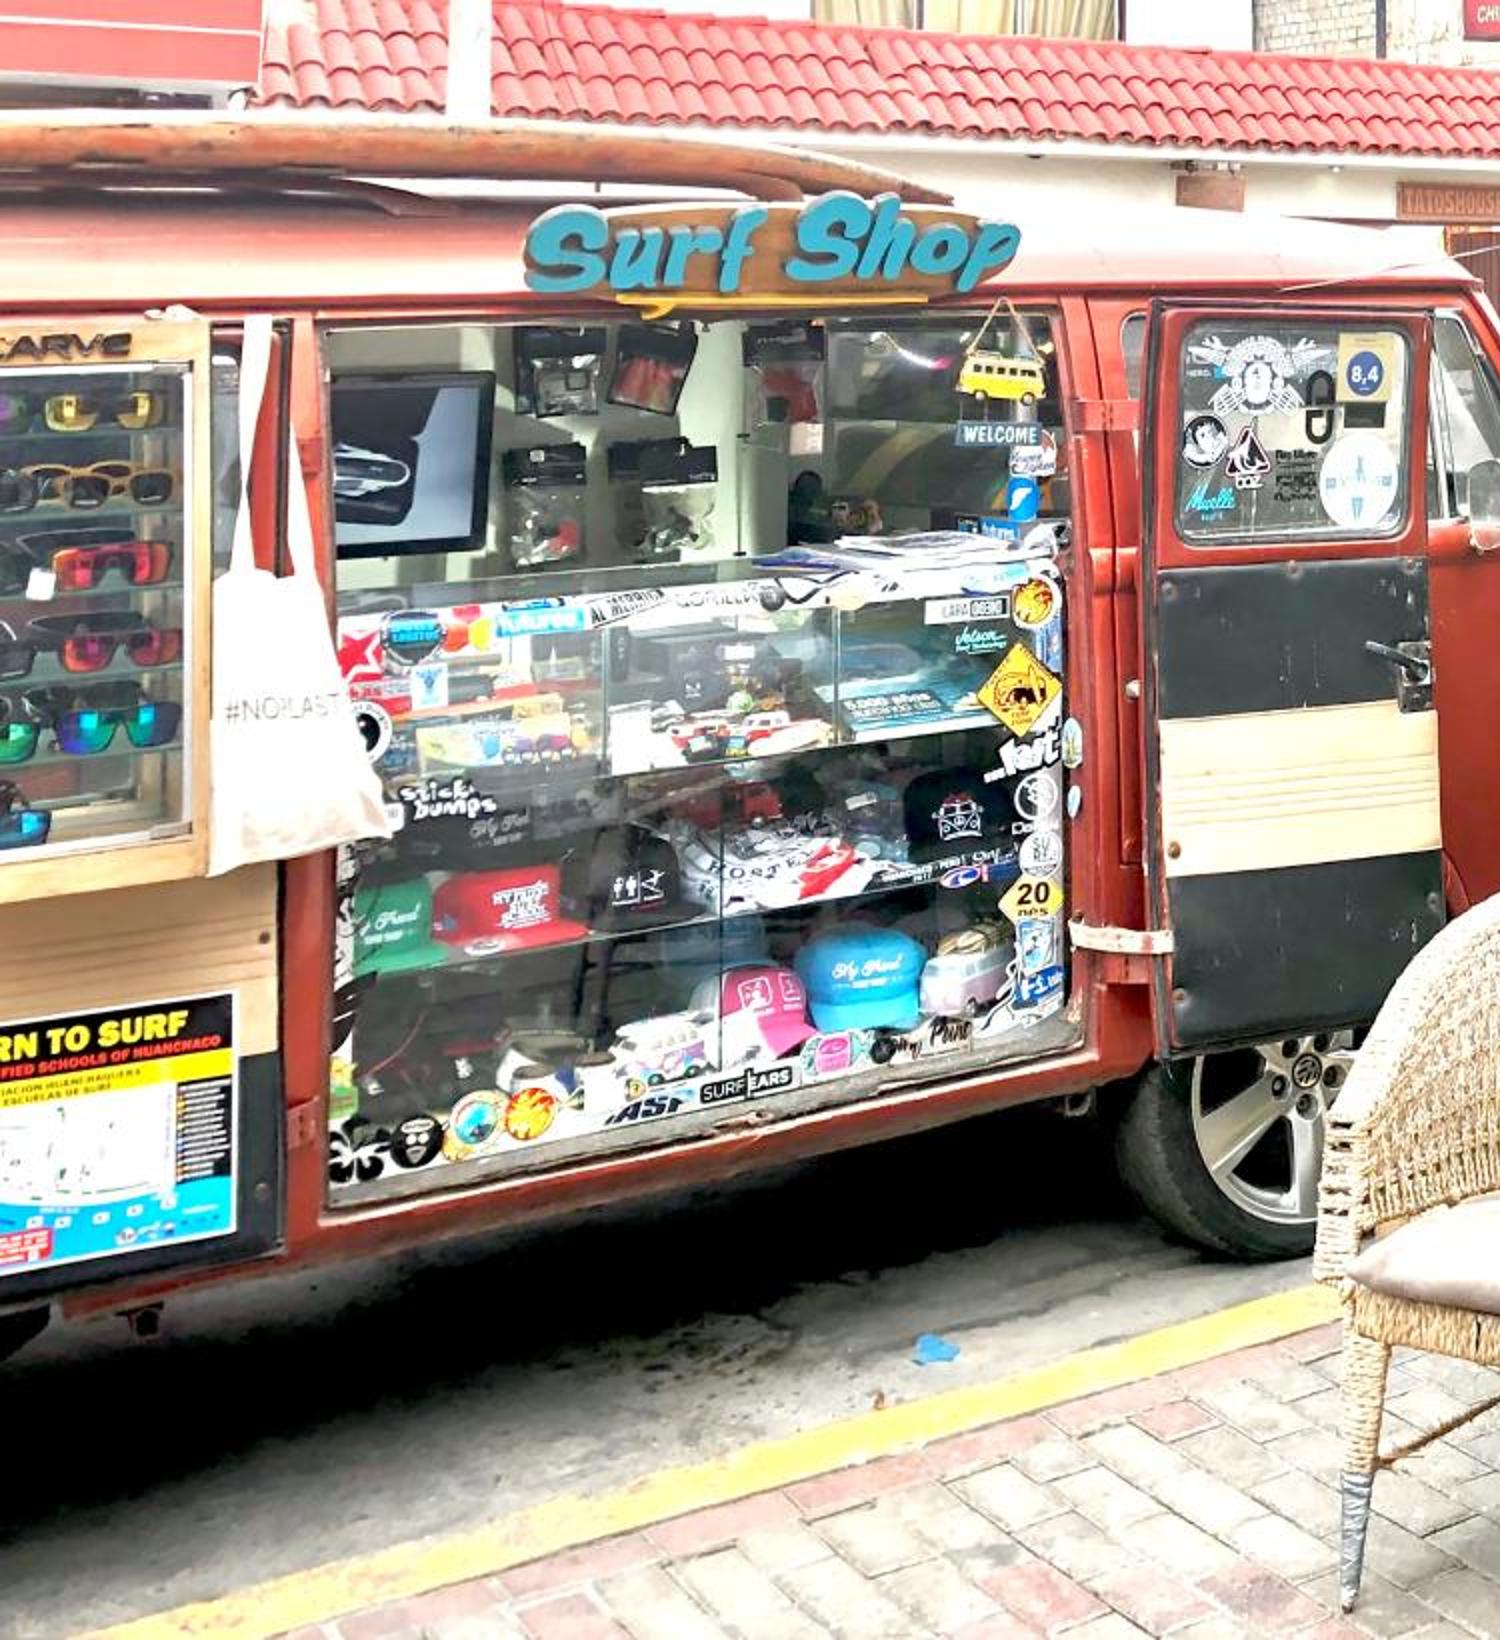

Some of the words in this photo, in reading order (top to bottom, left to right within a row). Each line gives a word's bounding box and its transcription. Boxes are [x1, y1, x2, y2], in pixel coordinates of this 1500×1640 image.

[523, 203, 768, 294] Surf
[786, 190, 1022, 294] Shop
[1350, 364, 1381, 385] 8,4
[962, 423, 1039, 445] WELCOME
[1017, 881, 1051, 905] 20
[46, 1024, 91, 1055] TO
[97, 1010, 189, 1048] SURF
[38, 1052, 107, 1073] SCHOOLS
[110, 1048, 129, 1063] OF
[133, 1035, 222, 1059] HUANCHACO
